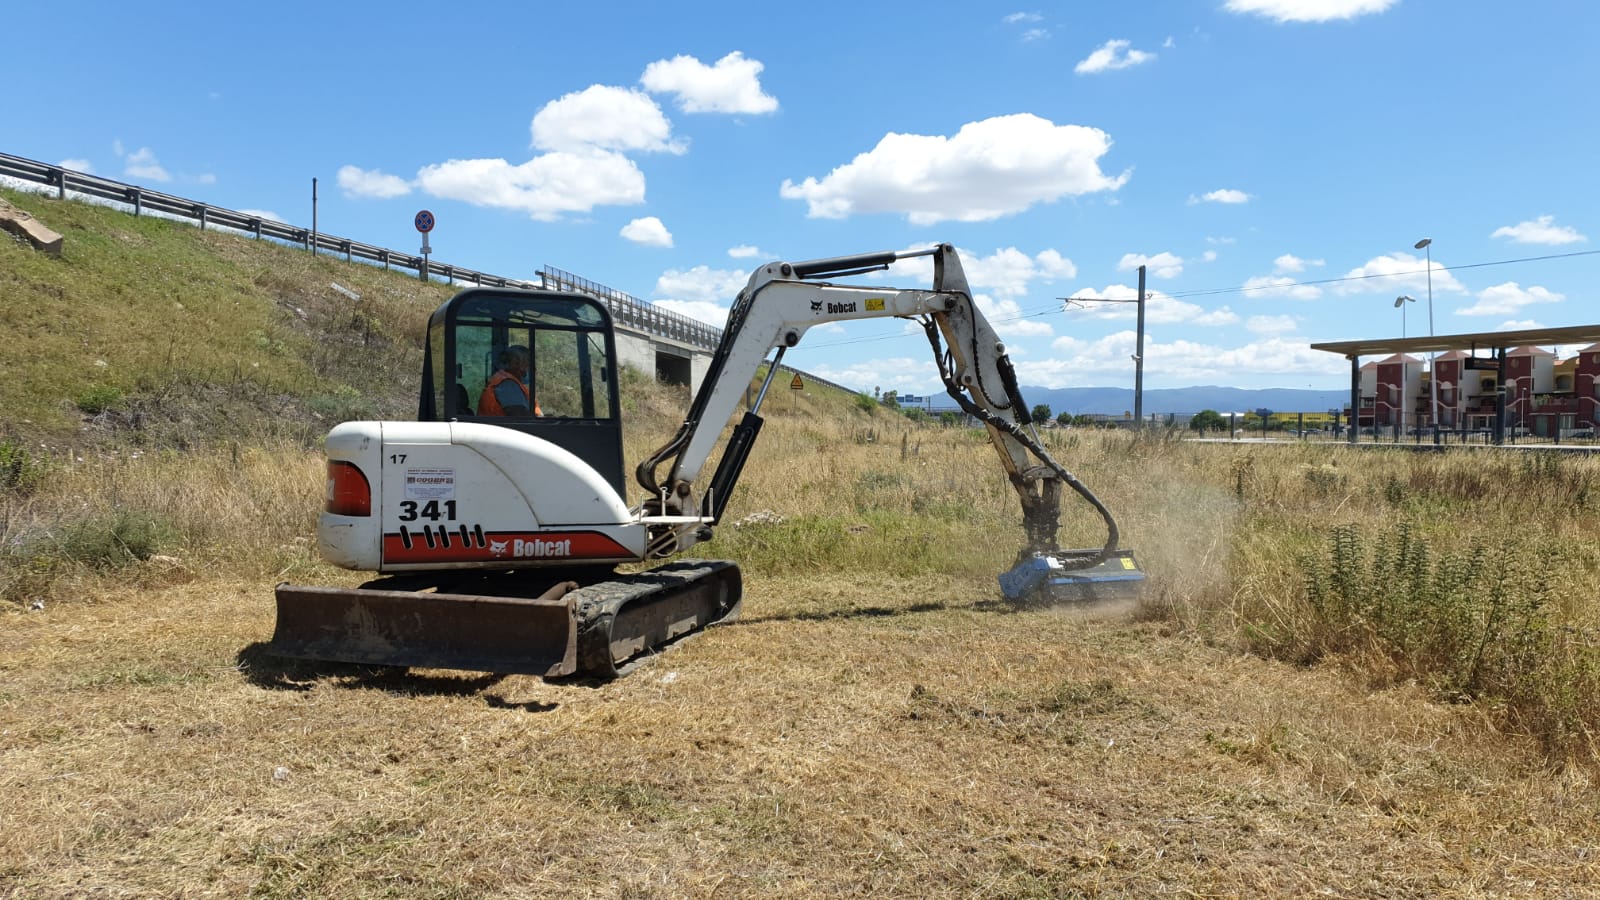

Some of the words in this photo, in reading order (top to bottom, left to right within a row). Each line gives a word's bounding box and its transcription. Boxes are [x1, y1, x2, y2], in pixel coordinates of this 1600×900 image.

[827, 301, 857, 314] Bobcat
[390, 454, 407, 465] 17
[398, 500, 456, 521] 341
[513, 538, 571, 557] Bobcat
